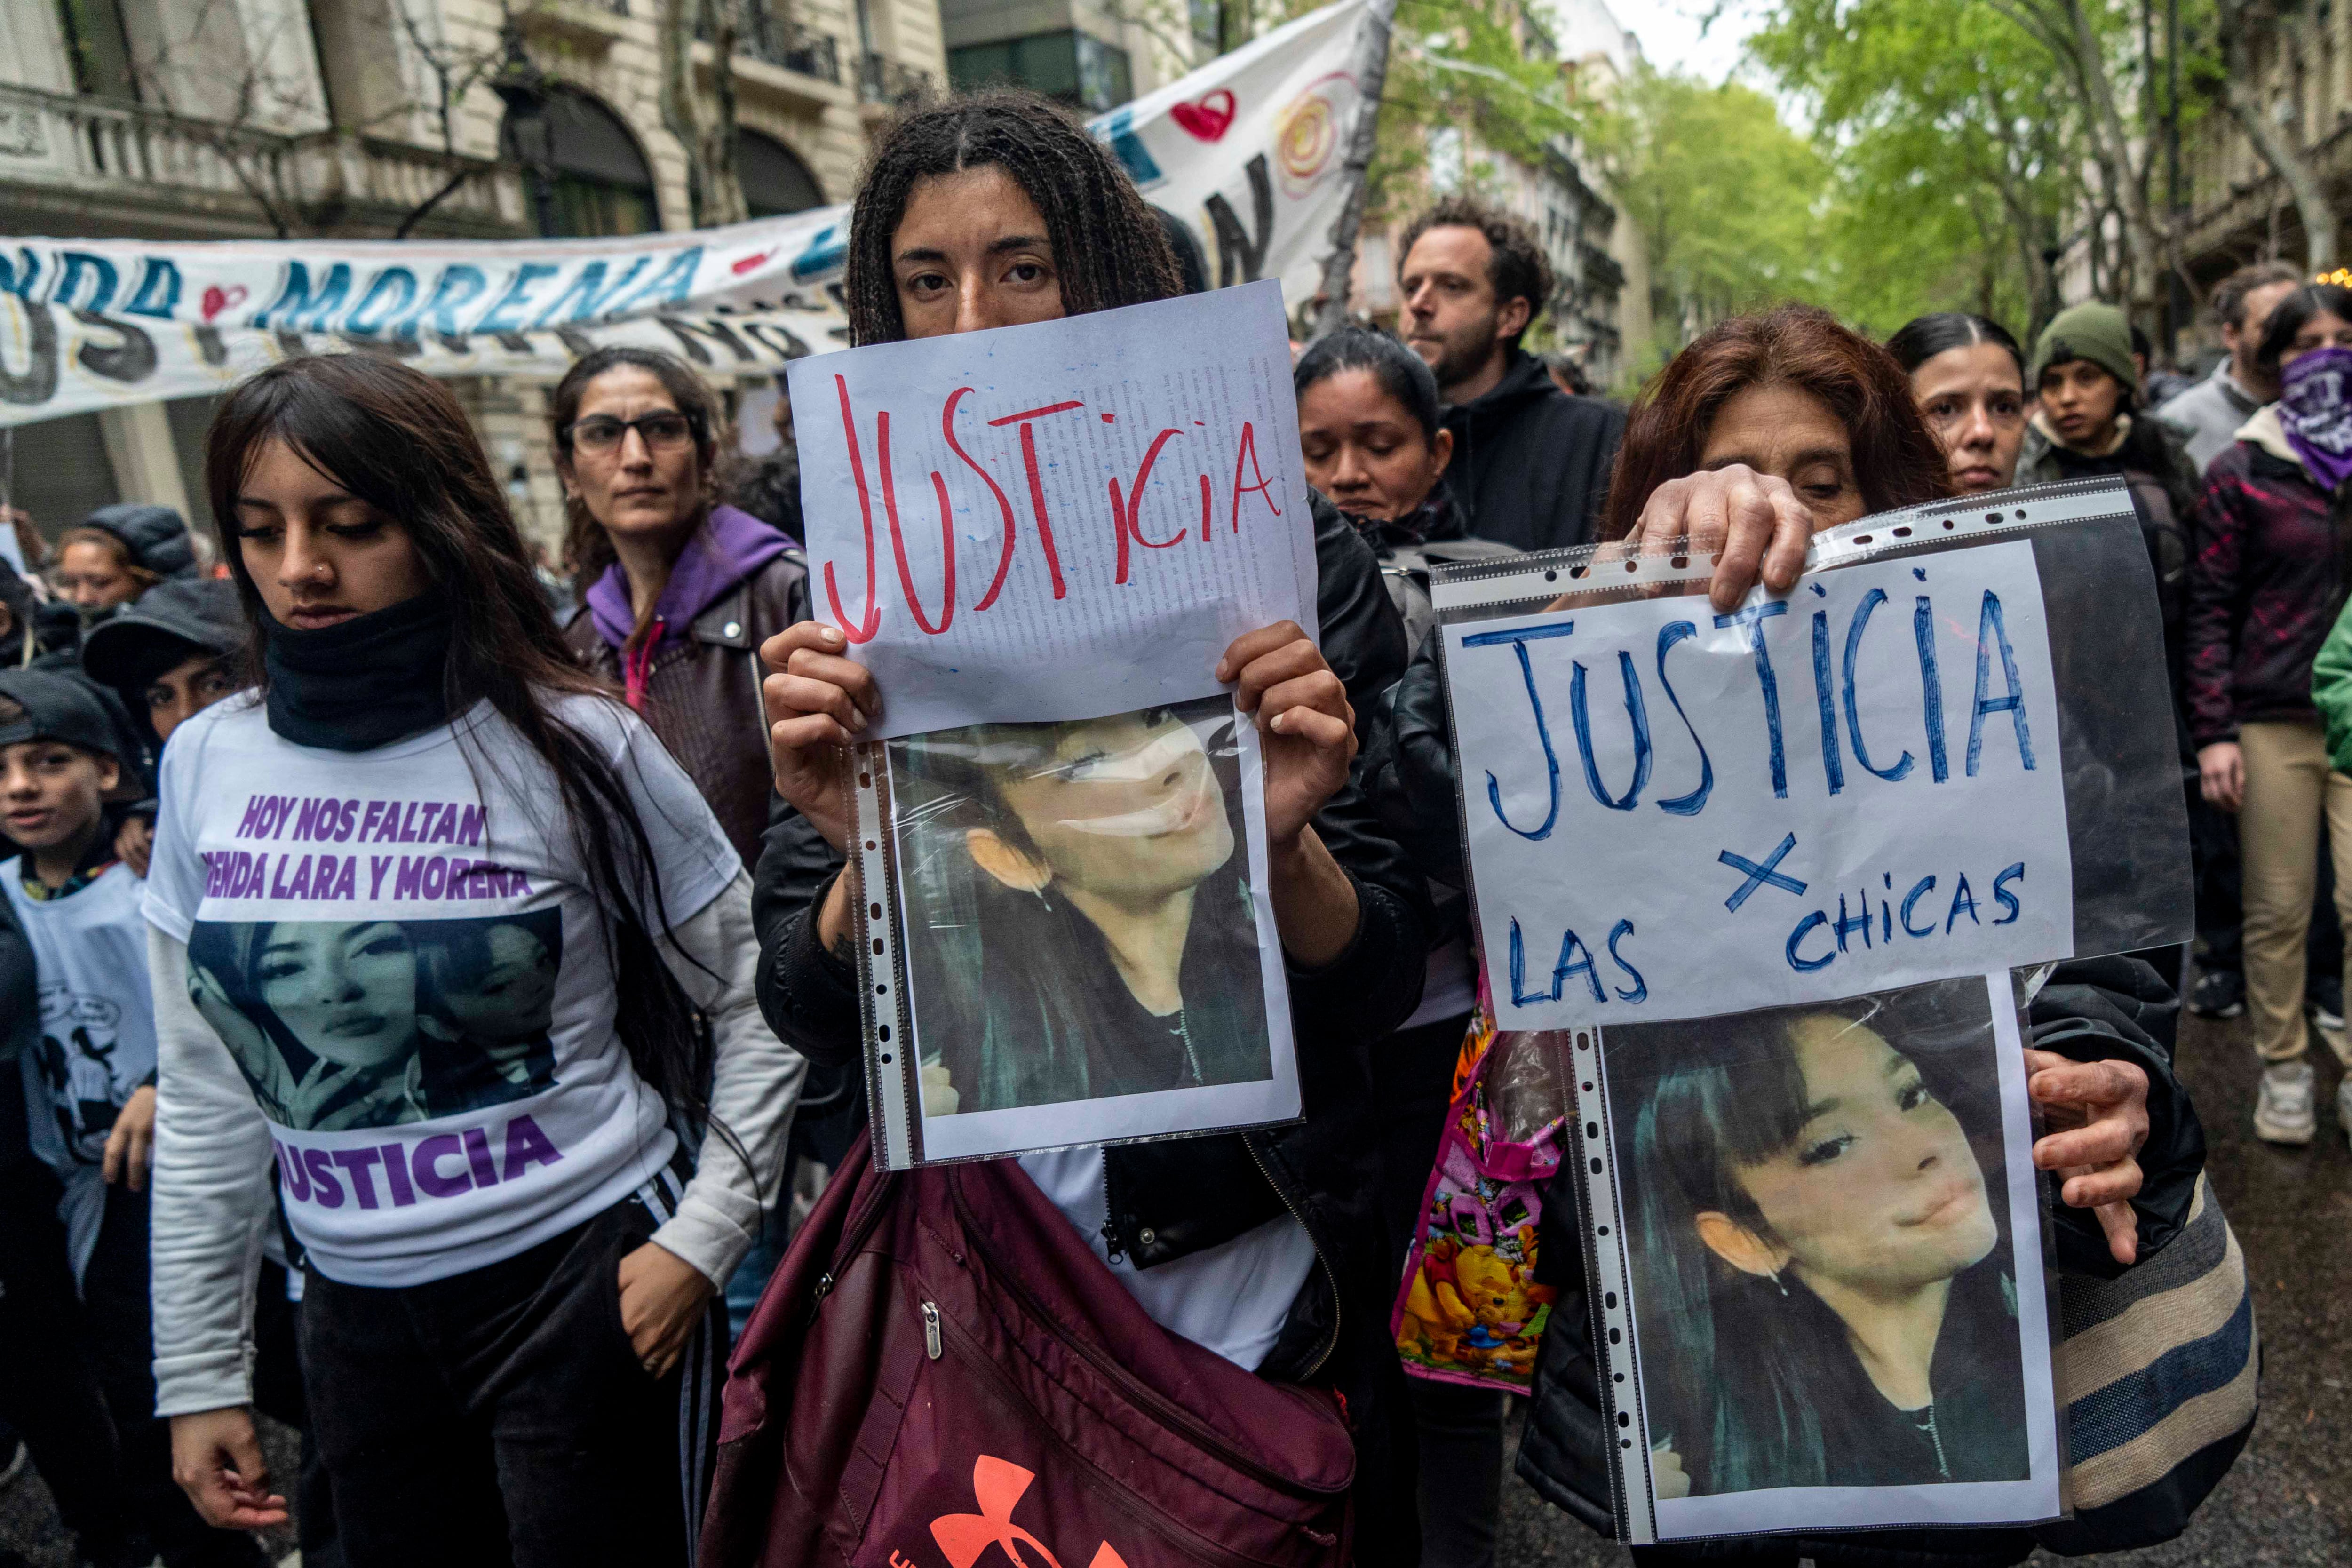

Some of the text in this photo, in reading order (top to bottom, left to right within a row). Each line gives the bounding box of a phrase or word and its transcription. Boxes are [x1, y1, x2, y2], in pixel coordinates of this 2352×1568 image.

[248, 243, 705, 335] MORENA
[236, 795, 488, 847] HOY NOS FALTAN
[270, 854, 357, 900] LARA
[369, 855, 394, 900] Y
[393, 855, 536, 900] MORENA
[1510, 915, 1649, 1009] LAS
